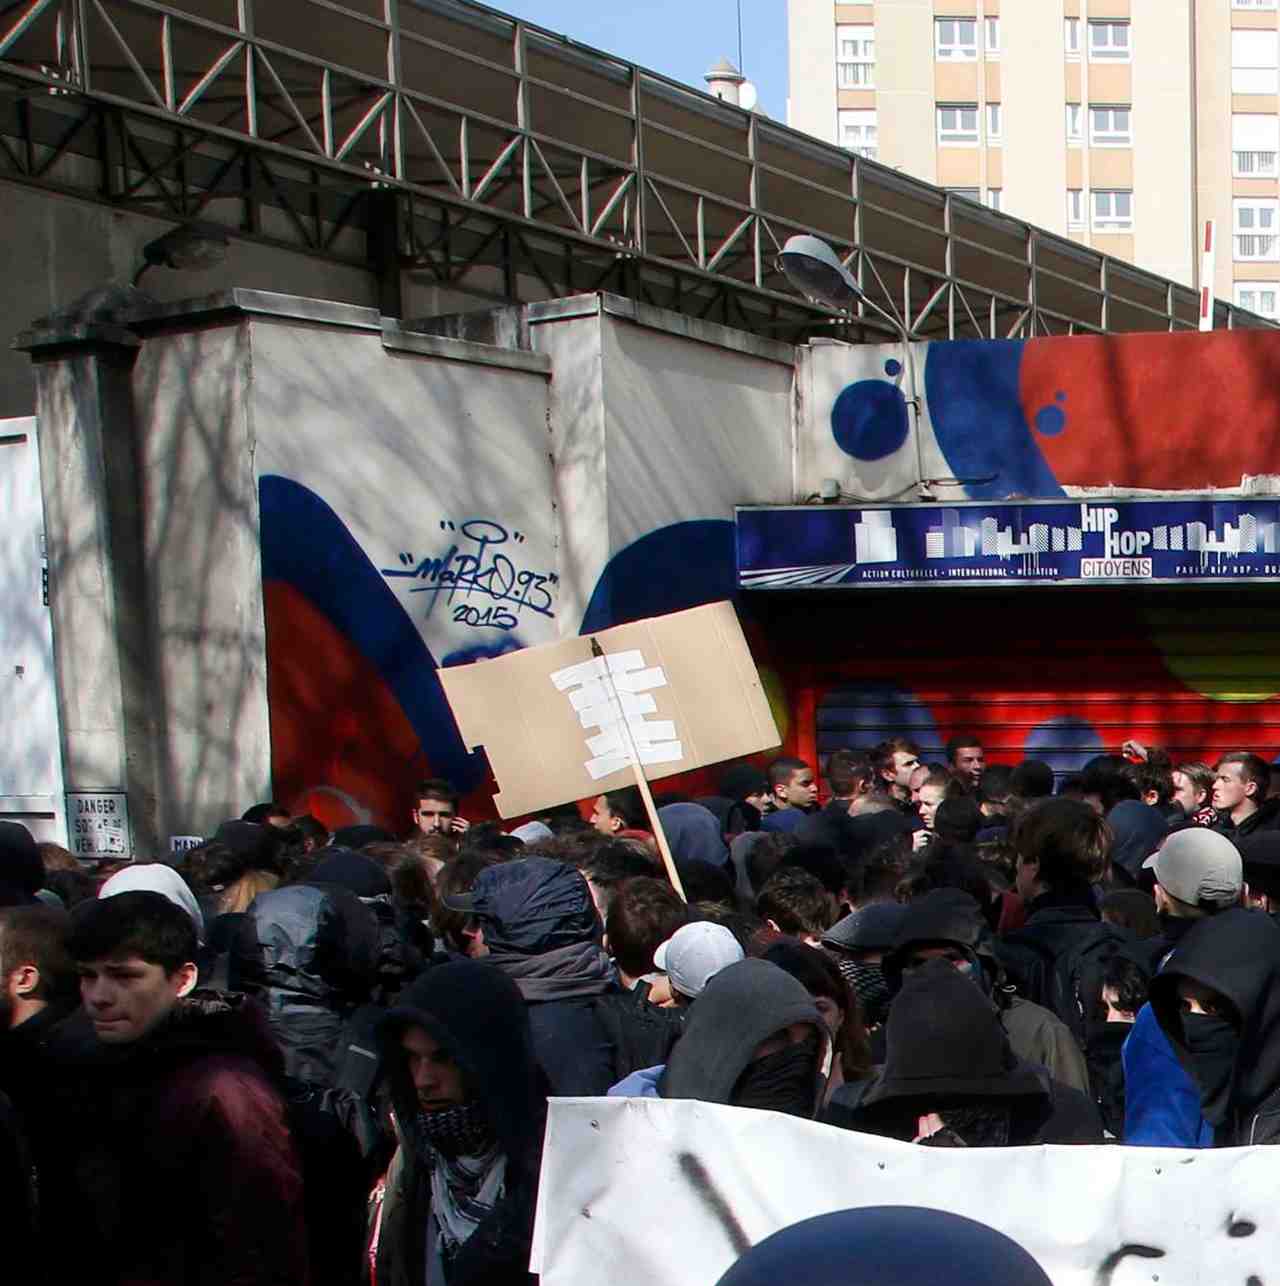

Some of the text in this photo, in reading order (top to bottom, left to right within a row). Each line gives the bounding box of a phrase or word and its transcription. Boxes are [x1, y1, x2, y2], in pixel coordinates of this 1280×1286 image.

[1081, 504, 1119, 532] HIP
[1110, 531, 1150, 555] HOP
[1083, 560, 1151, 577] CITOYENS
[453, 604, 518, 631] 2015
[76, 799, 116, 814] DANGER
